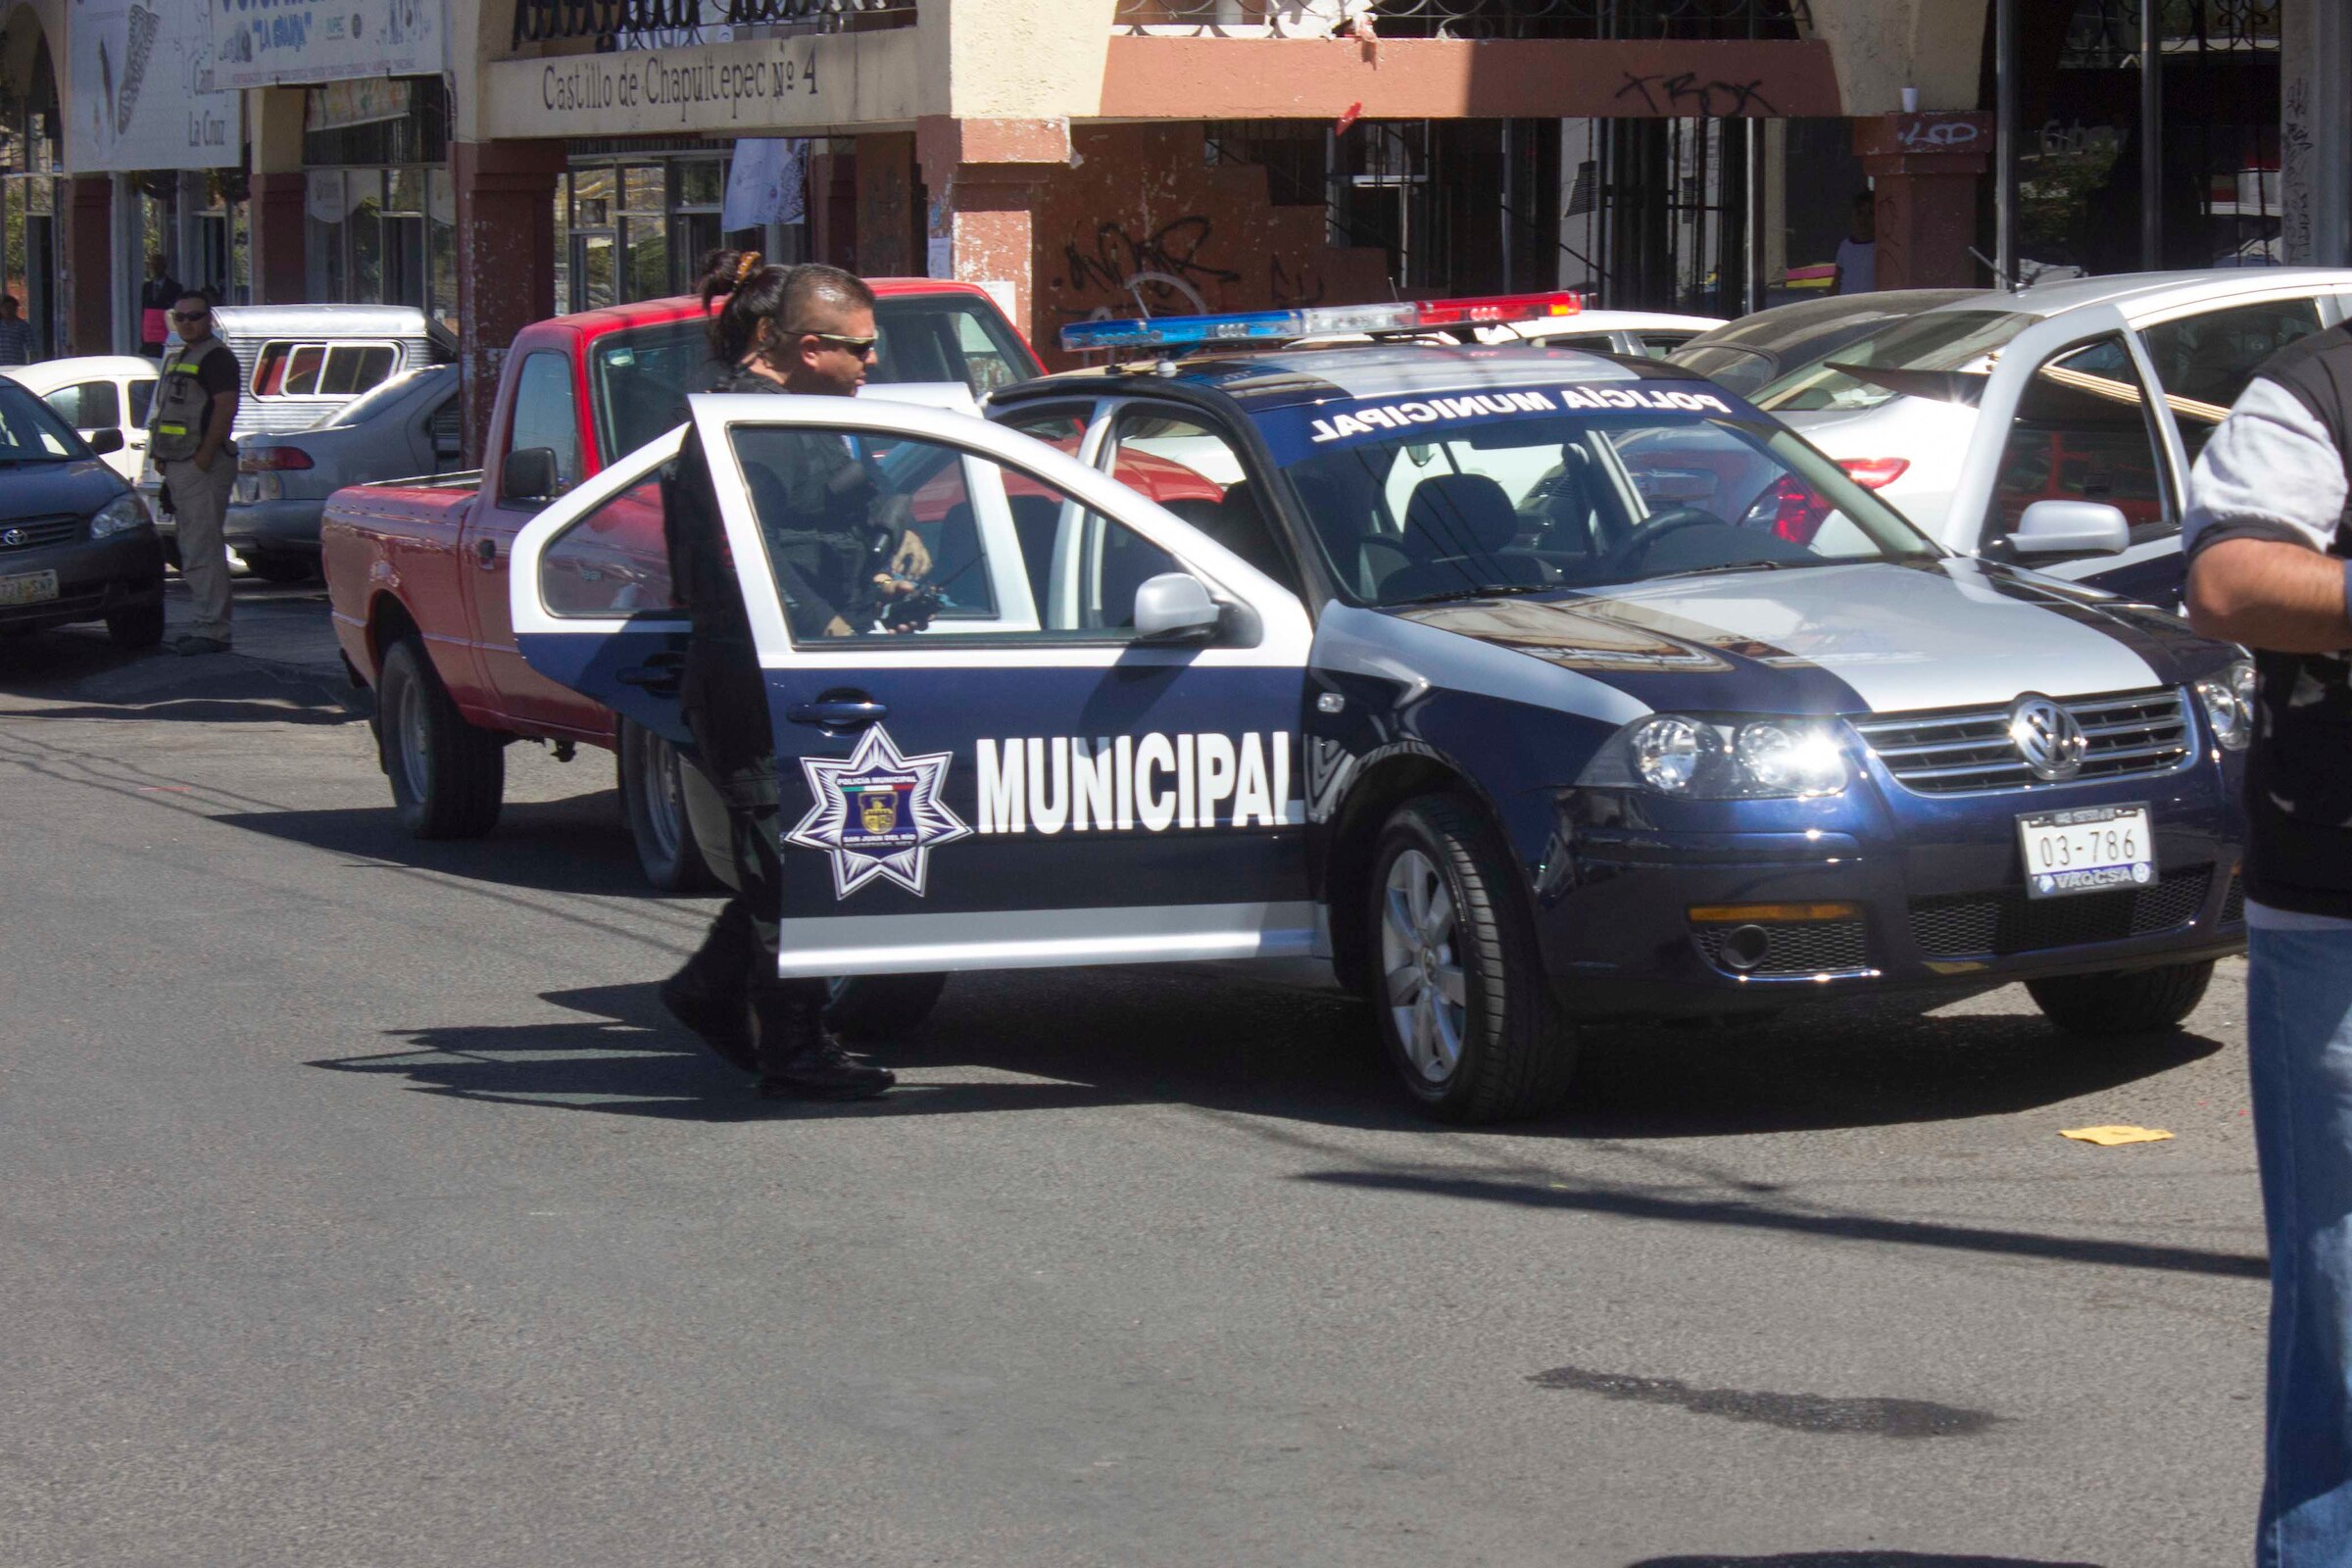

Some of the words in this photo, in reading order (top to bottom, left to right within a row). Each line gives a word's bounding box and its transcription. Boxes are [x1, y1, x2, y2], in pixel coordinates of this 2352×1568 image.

[542, 64, 612, 110] Castillo
[618, 62, 638, 107] de
[644, 54, 766, 122] Chapultepec
[803, 47, 818, 95] 4
[188, 110, 201, 147] La
[203, 109, 225, 147] Cruz
[976, 732, 1305, 834] MUNICIPAL
[2040, 828, 2135, 867] 03-786
